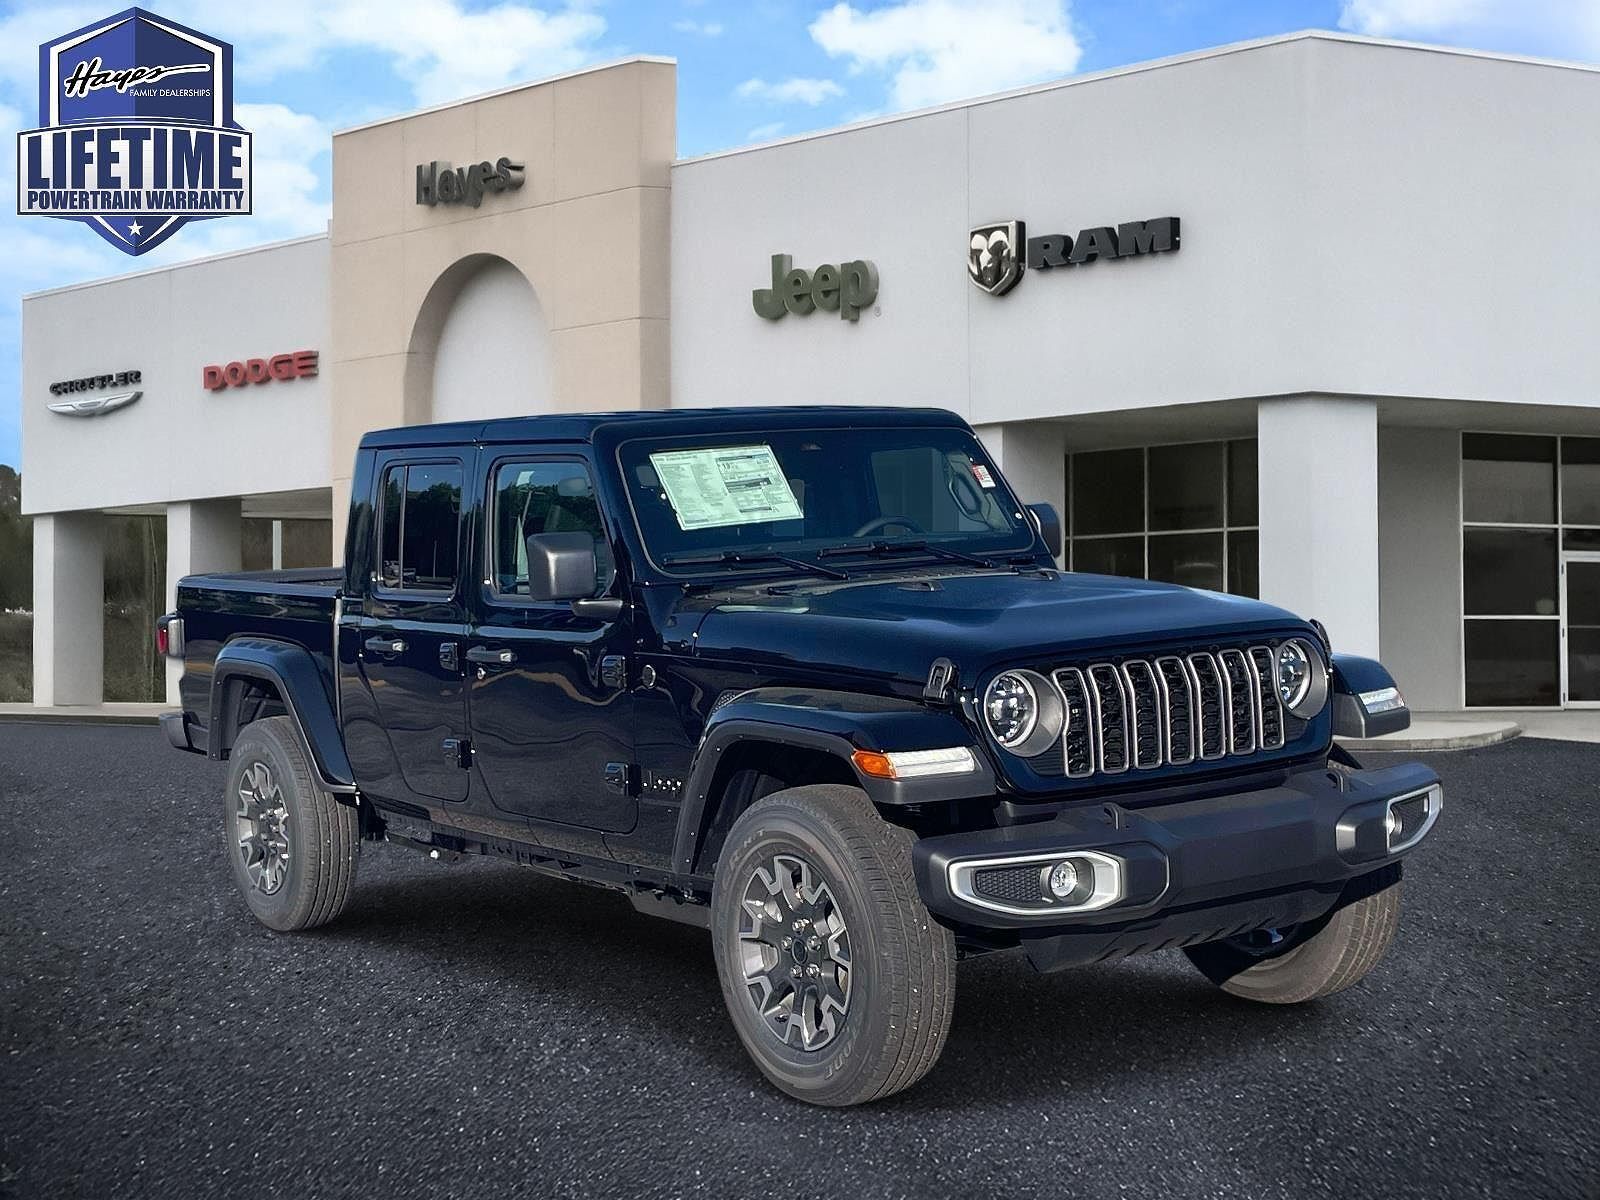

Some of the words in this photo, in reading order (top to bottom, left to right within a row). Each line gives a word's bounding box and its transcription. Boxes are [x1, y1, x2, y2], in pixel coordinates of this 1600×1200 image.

[416, 157, 525, 208] Hayes
[1027, 216, 1181, 269] RAM
[752, 253, 880, 321] Jeep
[203, 350, 319, 391] DODGE
